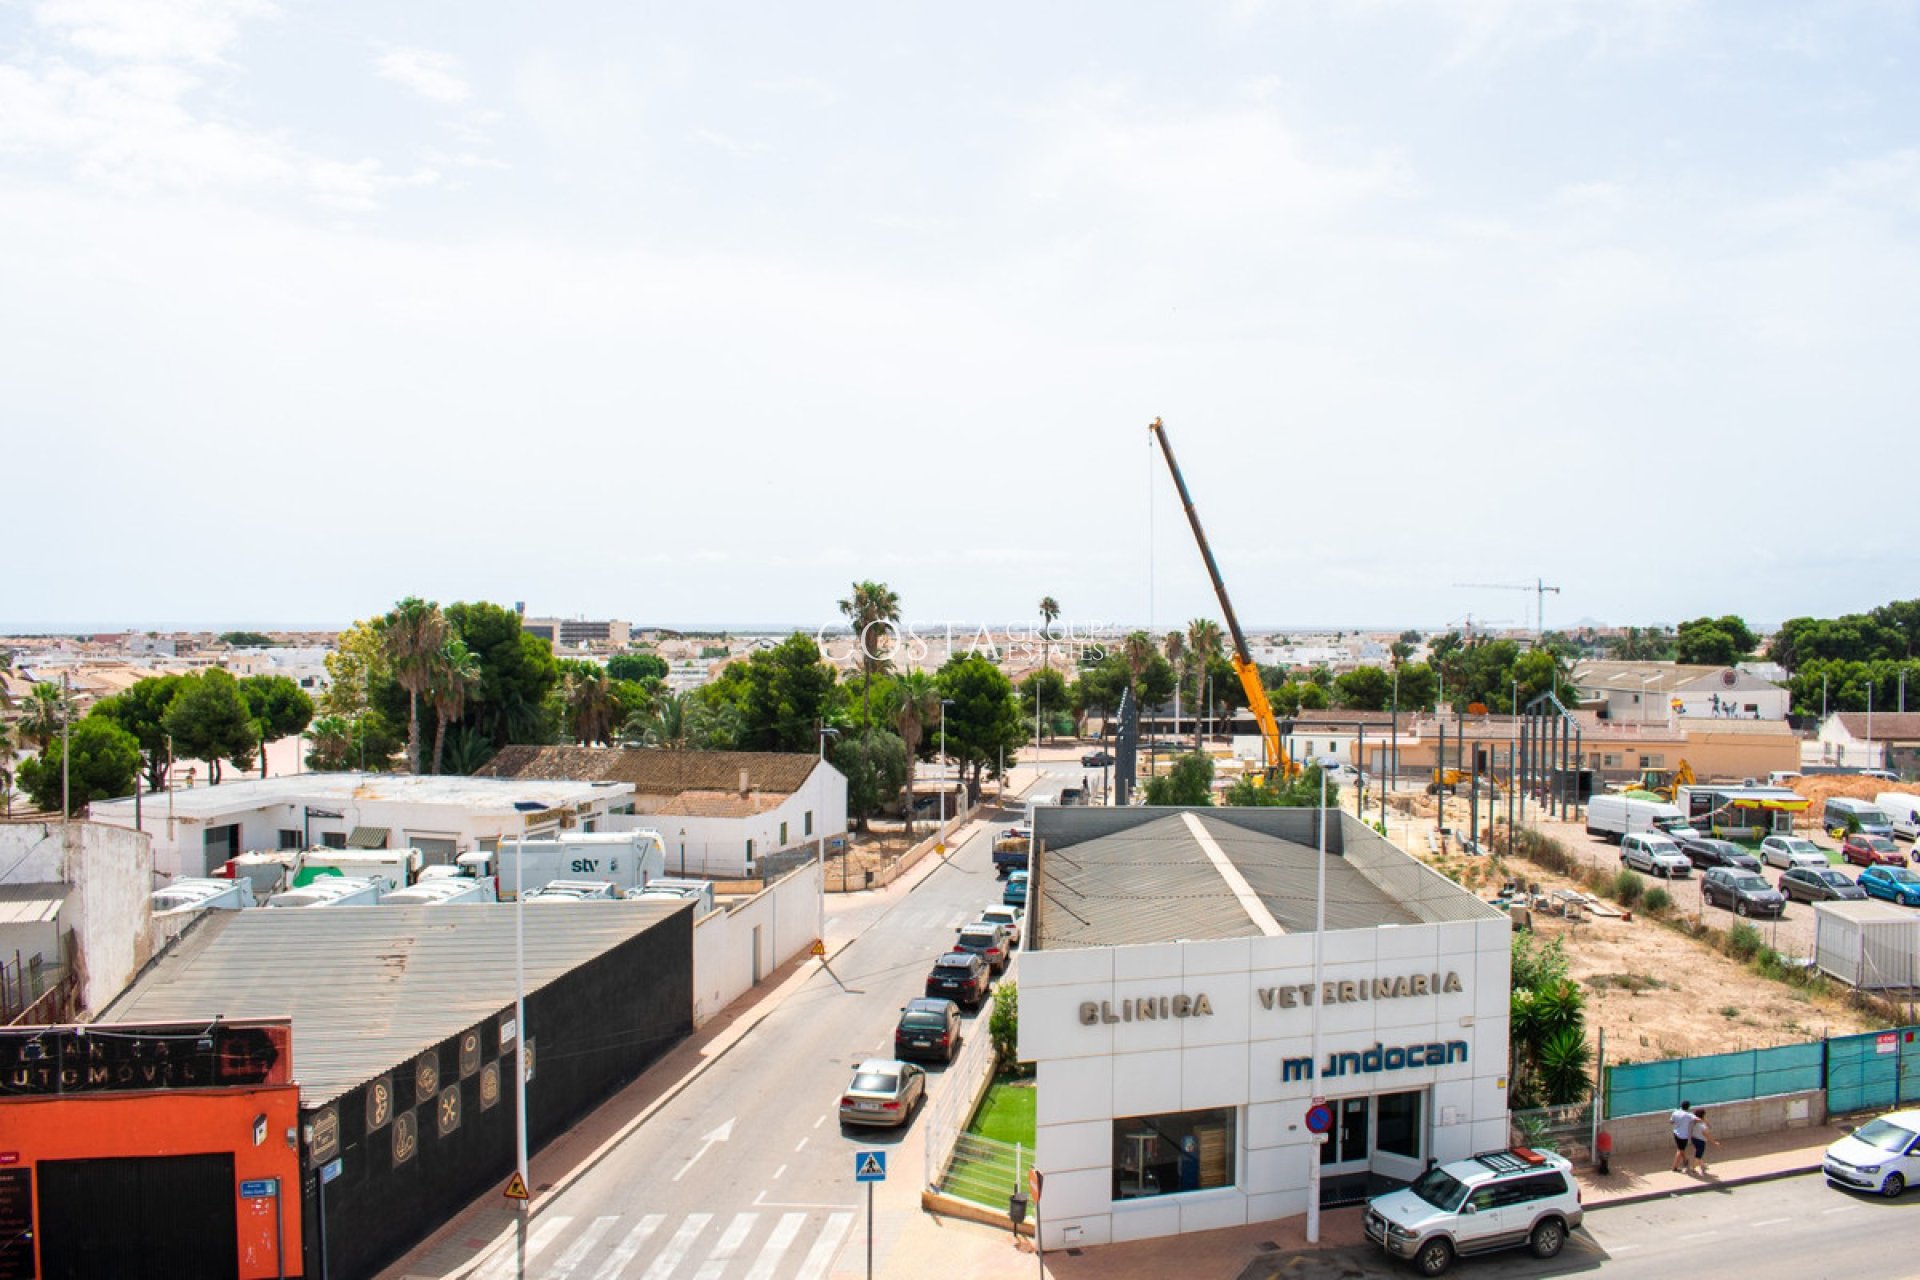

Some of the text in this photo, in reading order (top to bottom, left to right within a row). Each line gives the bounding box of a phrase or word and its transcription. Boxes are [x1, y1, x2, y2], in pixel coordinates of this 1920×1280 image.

[571, 858, 599, 873] stv
[1079, 972, 1463, 1026] CLINICA VETERINARIA
